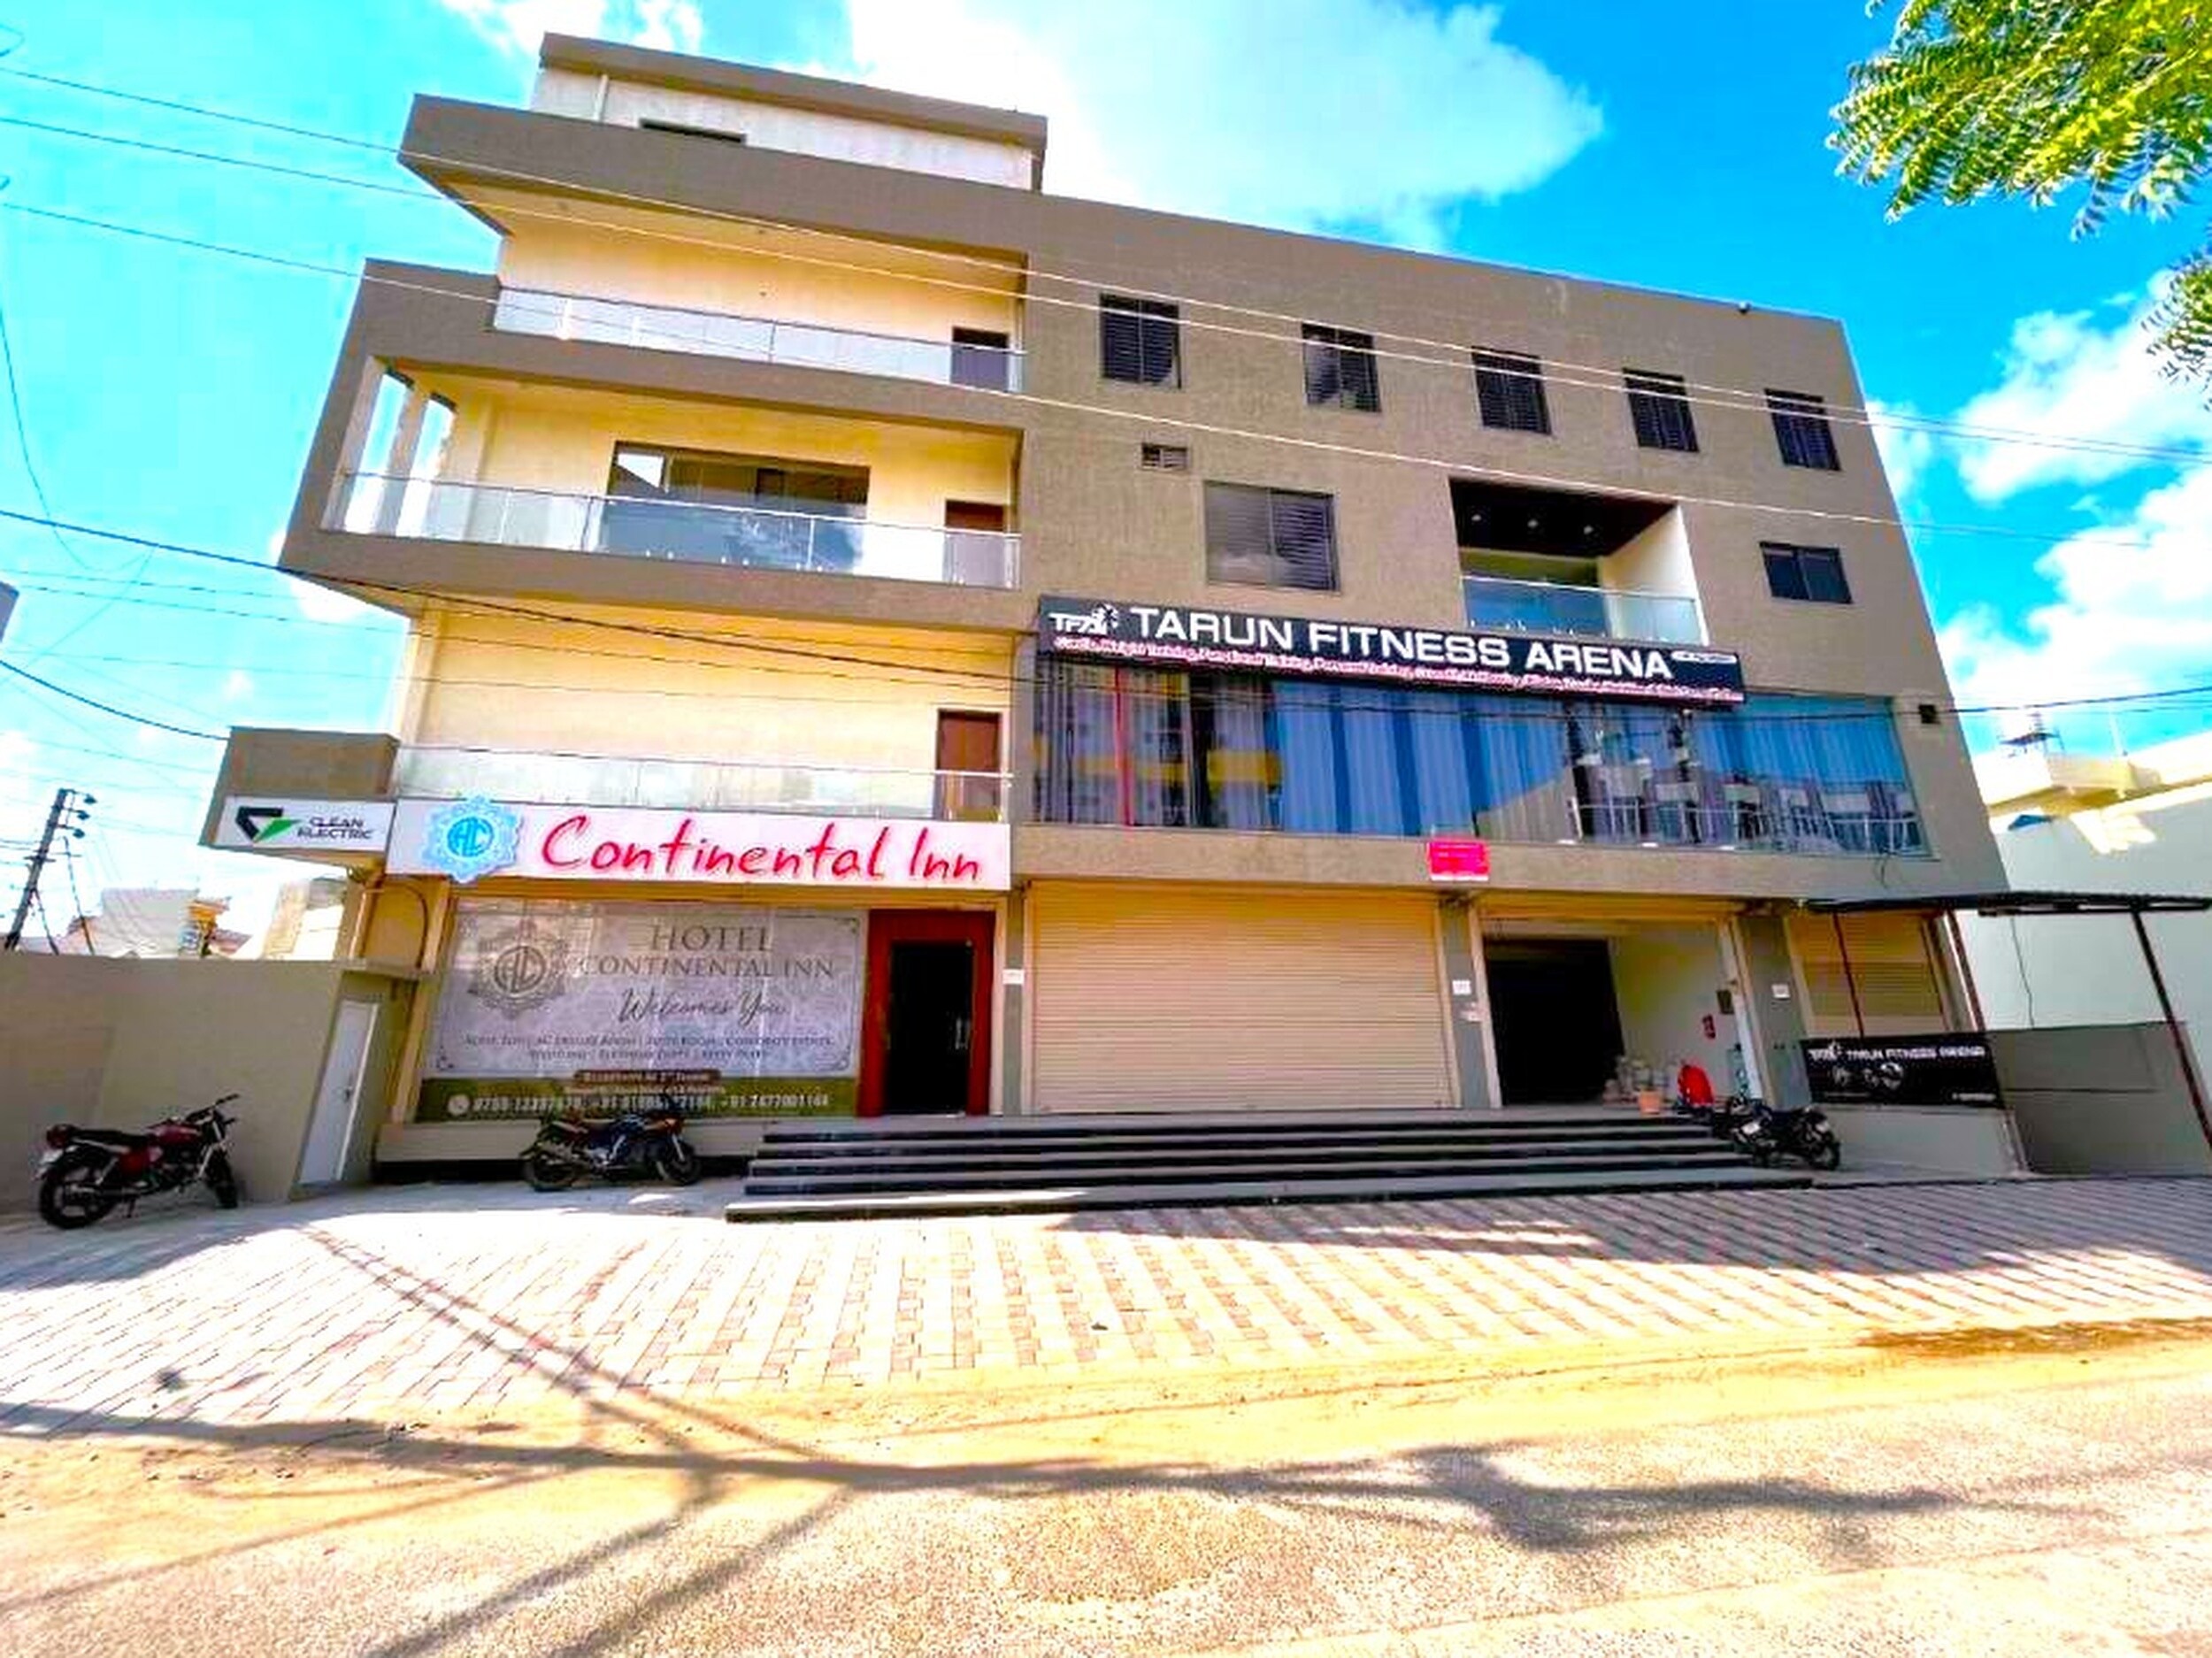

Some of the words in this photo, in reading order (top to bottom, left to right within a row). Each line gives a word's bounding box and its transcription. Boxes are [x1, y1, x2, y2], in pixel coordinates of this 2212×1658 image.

[1129, 606, 1293, 651] TARUN
[1307, 623, 1510, 667] FITNESS
[1524, 641, 1673, 679] ARENA
[309, 816, 364, 828] CLEAN
[541, 814, 892, 879] Continental
[908, 826, 985, 881] Inn
[650, 924, 773, 952] HOTEL
[578, 955, 773, 978] CONTINENTAL
[784, 958, 835, 979] INN
[618, 986, 733, 1023] Welcomes
[739, 989, 787, 1030] You
